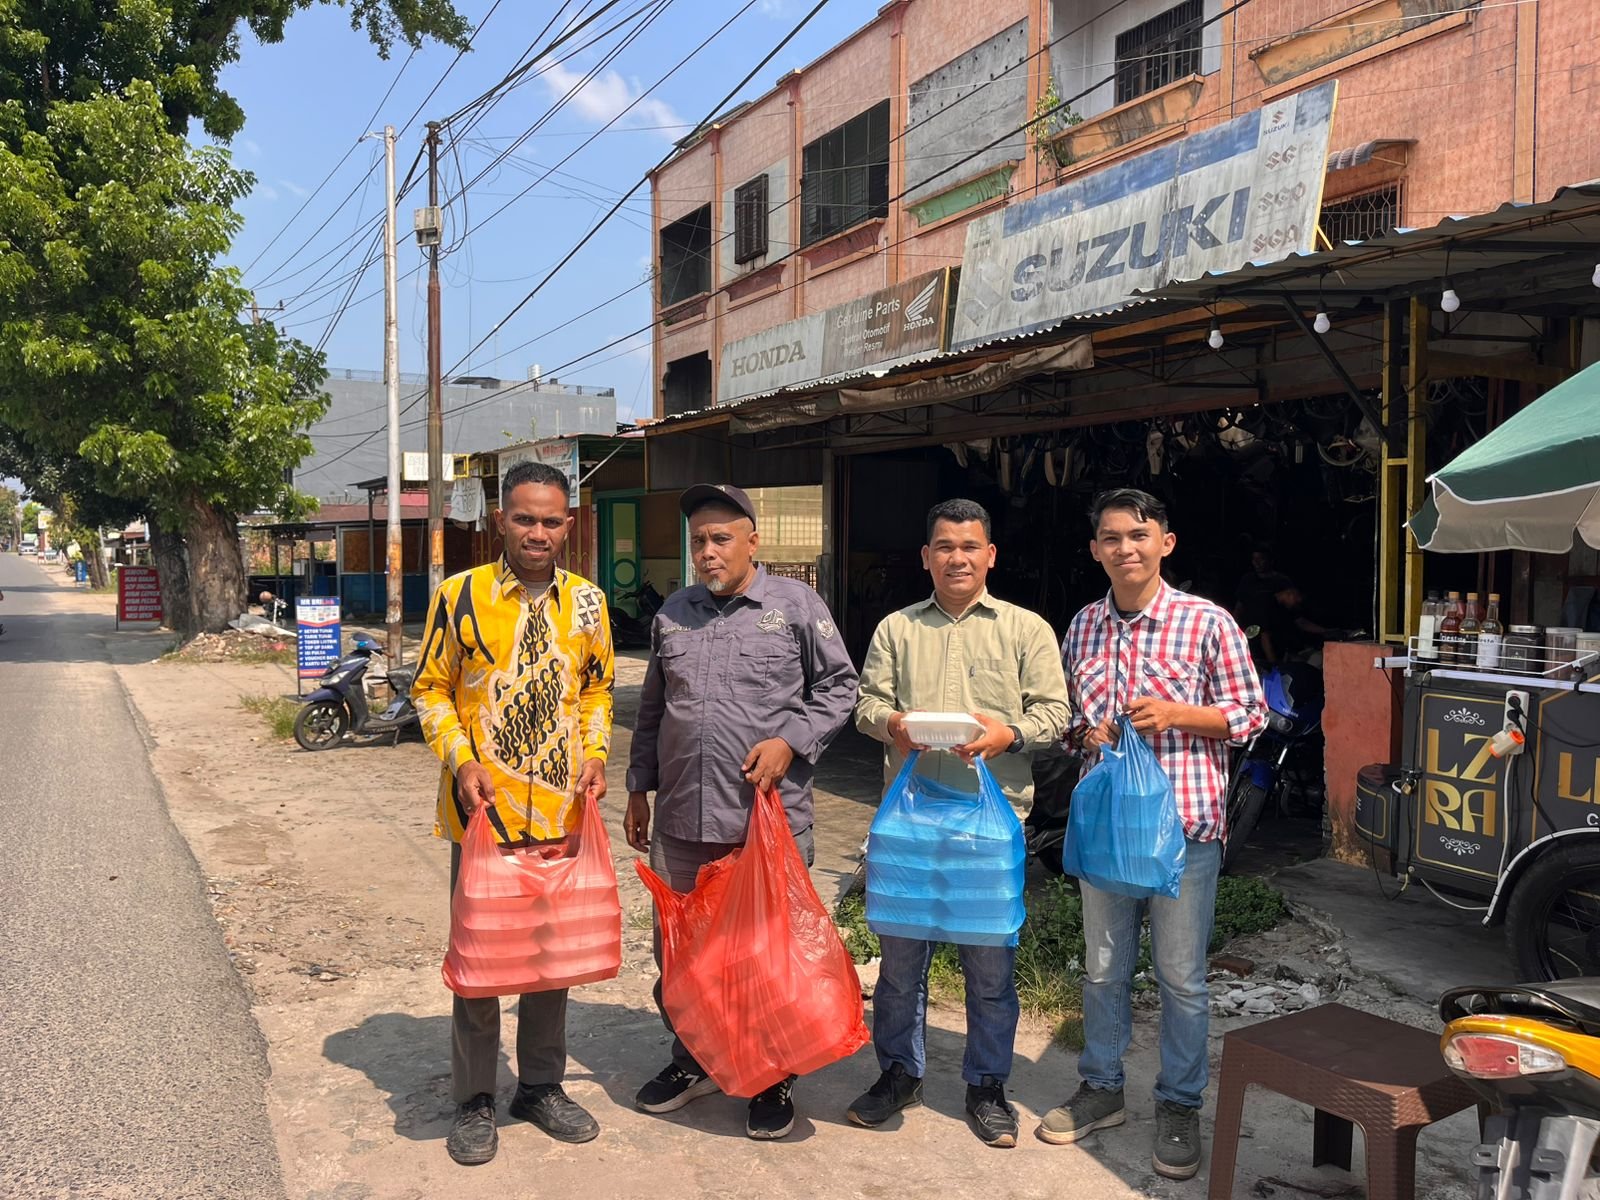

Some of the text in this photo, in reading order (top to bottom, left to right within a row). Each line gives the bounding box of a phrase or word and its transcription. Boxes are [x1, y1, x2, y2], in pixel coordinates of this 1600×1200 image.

[1263, 123, 1289, 135] SUZUKI
[1010, 186, 1251, 302] SUZUKI
[875, 298, 901, 318] Parts
[862, 322, 891, 340] Otomotif
[903, 316, 935, 332] HONDA
[731, 340, 807, 378] HONDA
[864, 341, 883, 352] Resmi
[1425, 728, 1497, 785] LZ
[1558, 751, 1600, 806] L
[1424, 779, 1497, 837] RA
